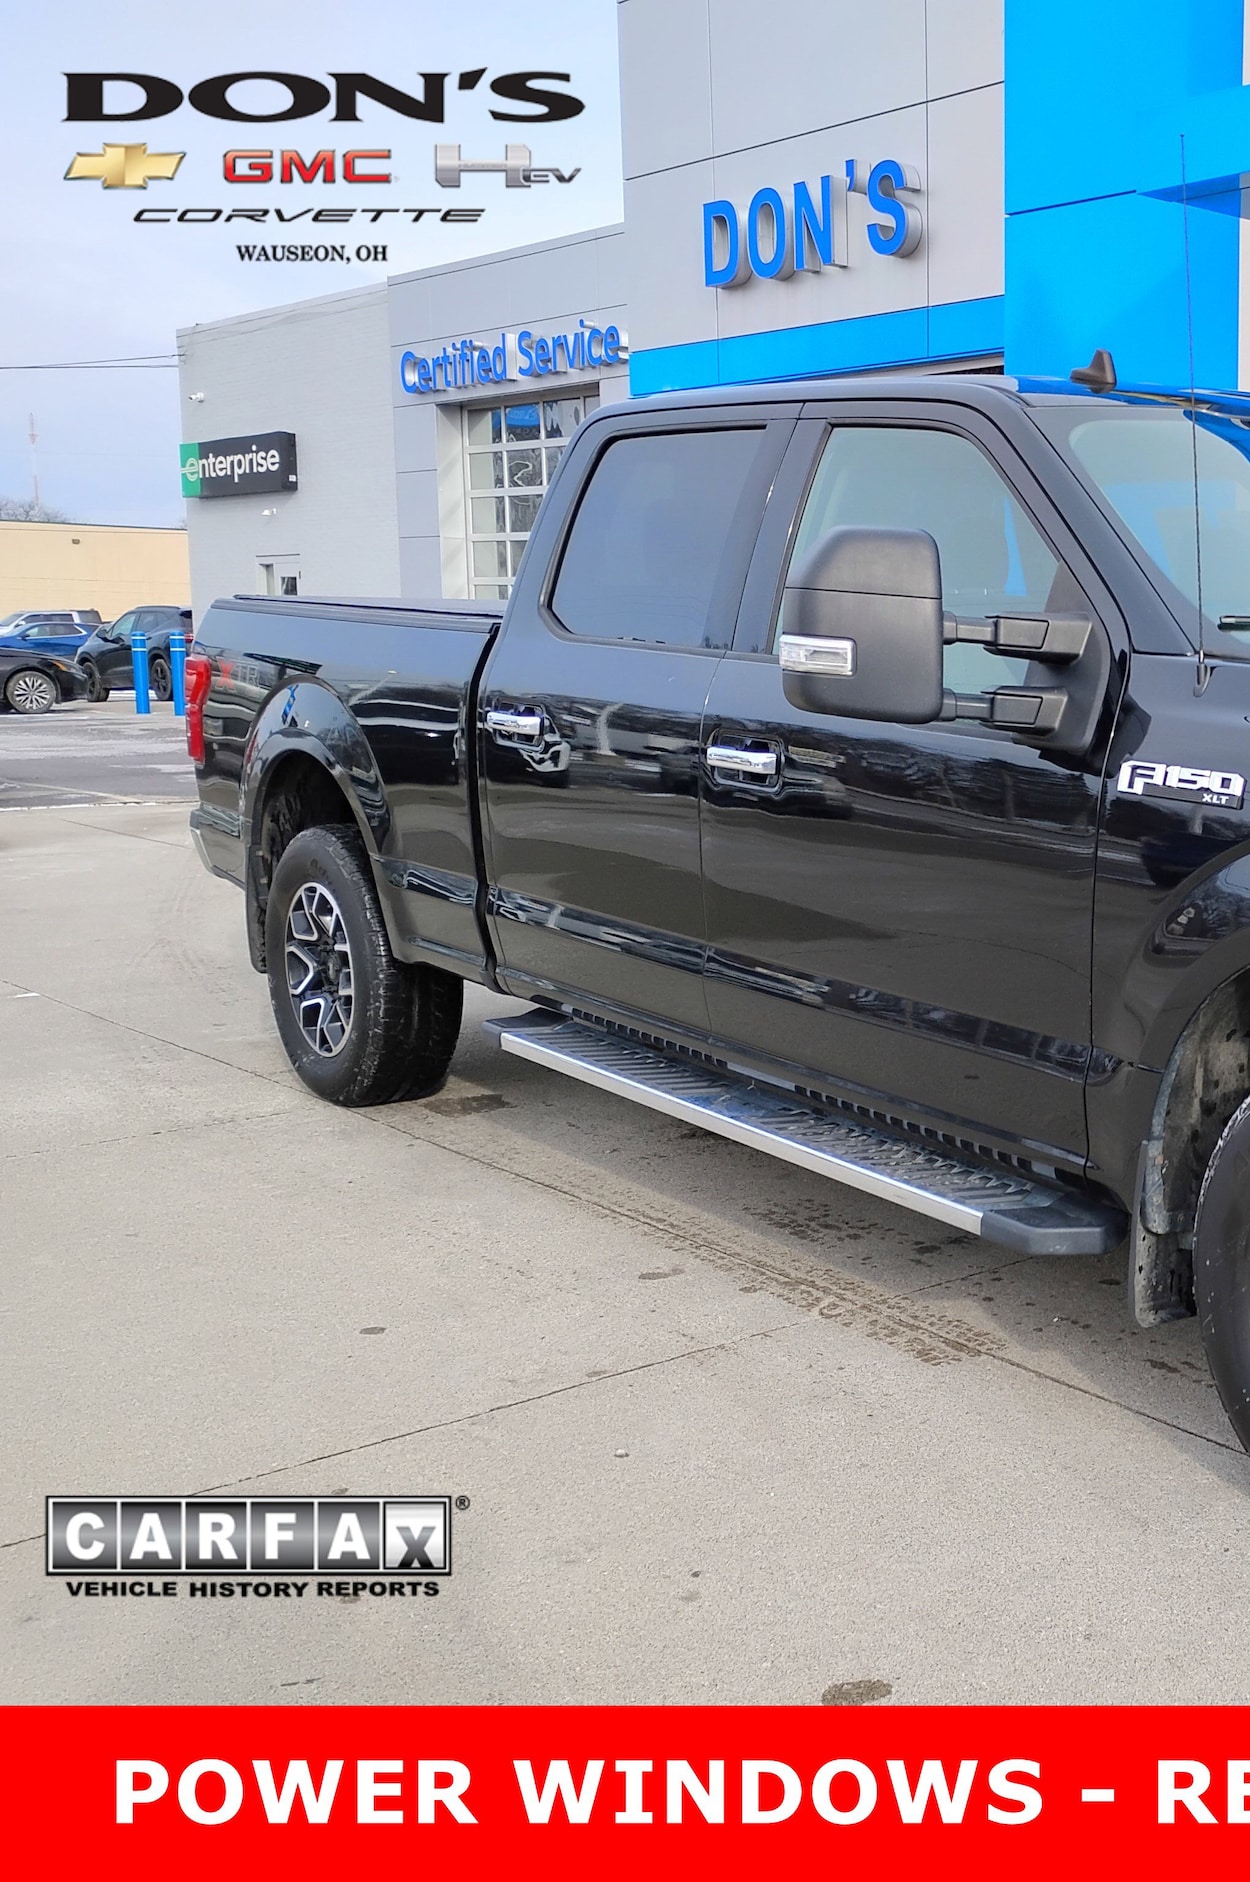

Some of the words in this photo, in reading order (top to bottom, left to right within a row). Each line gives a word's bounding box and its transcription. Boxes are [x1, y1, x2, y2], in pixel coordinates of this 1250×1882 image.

[703, 159, 908, 287] DON'S
[400, 333, 508, 394] Certified
[517, 318, 621, 377] Service
[181, 444, 280, 482] enterprise
[1202, 793, 1230, 805] XLT
